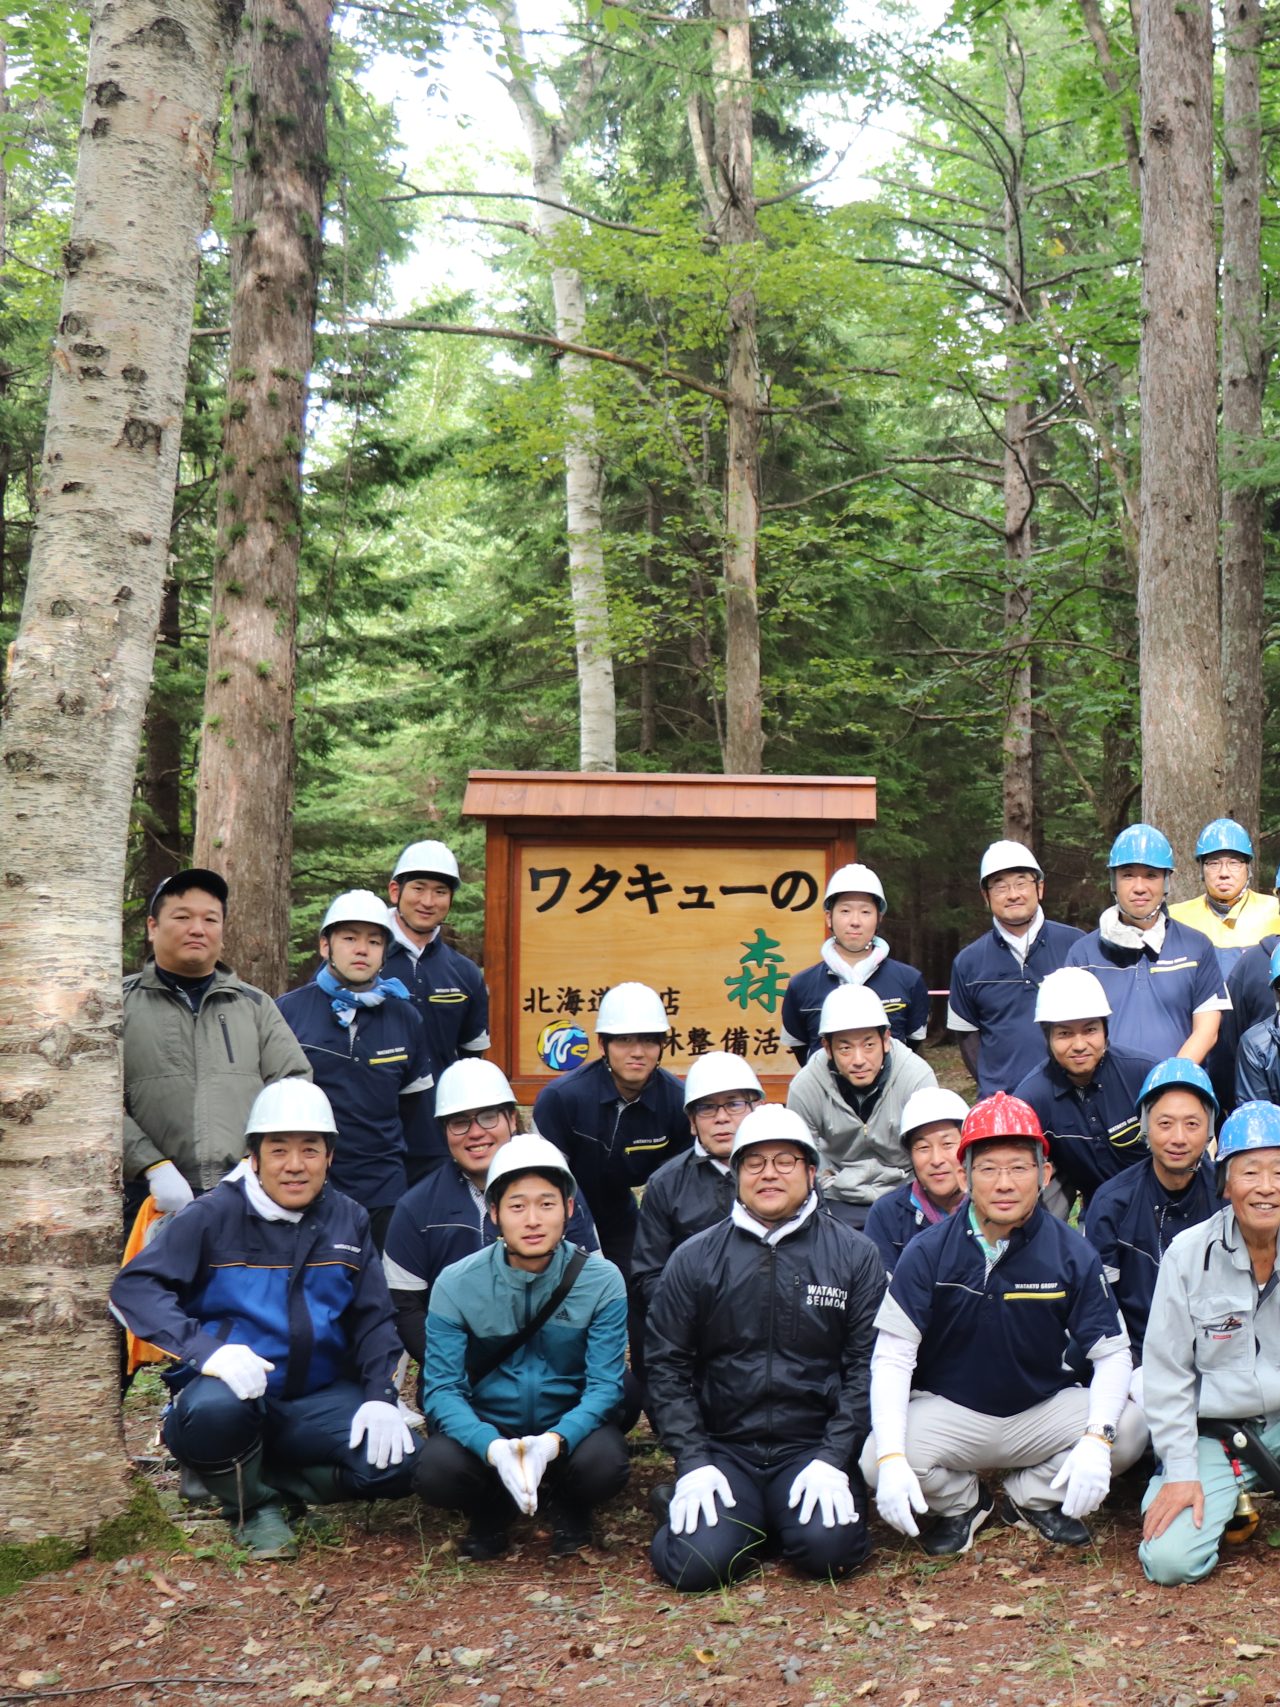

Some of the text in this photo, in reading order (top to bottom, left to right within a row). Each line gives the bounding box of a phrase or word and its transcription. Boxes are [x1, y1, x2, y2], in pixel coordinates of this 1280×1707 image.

[528, 863, 819, 915] ワタキューの
[723, 927, 791, 1013] 森
[806, 1295, 846, 1311] SEIMOA
[807, 1284, 848, 1301] WATAKYU
